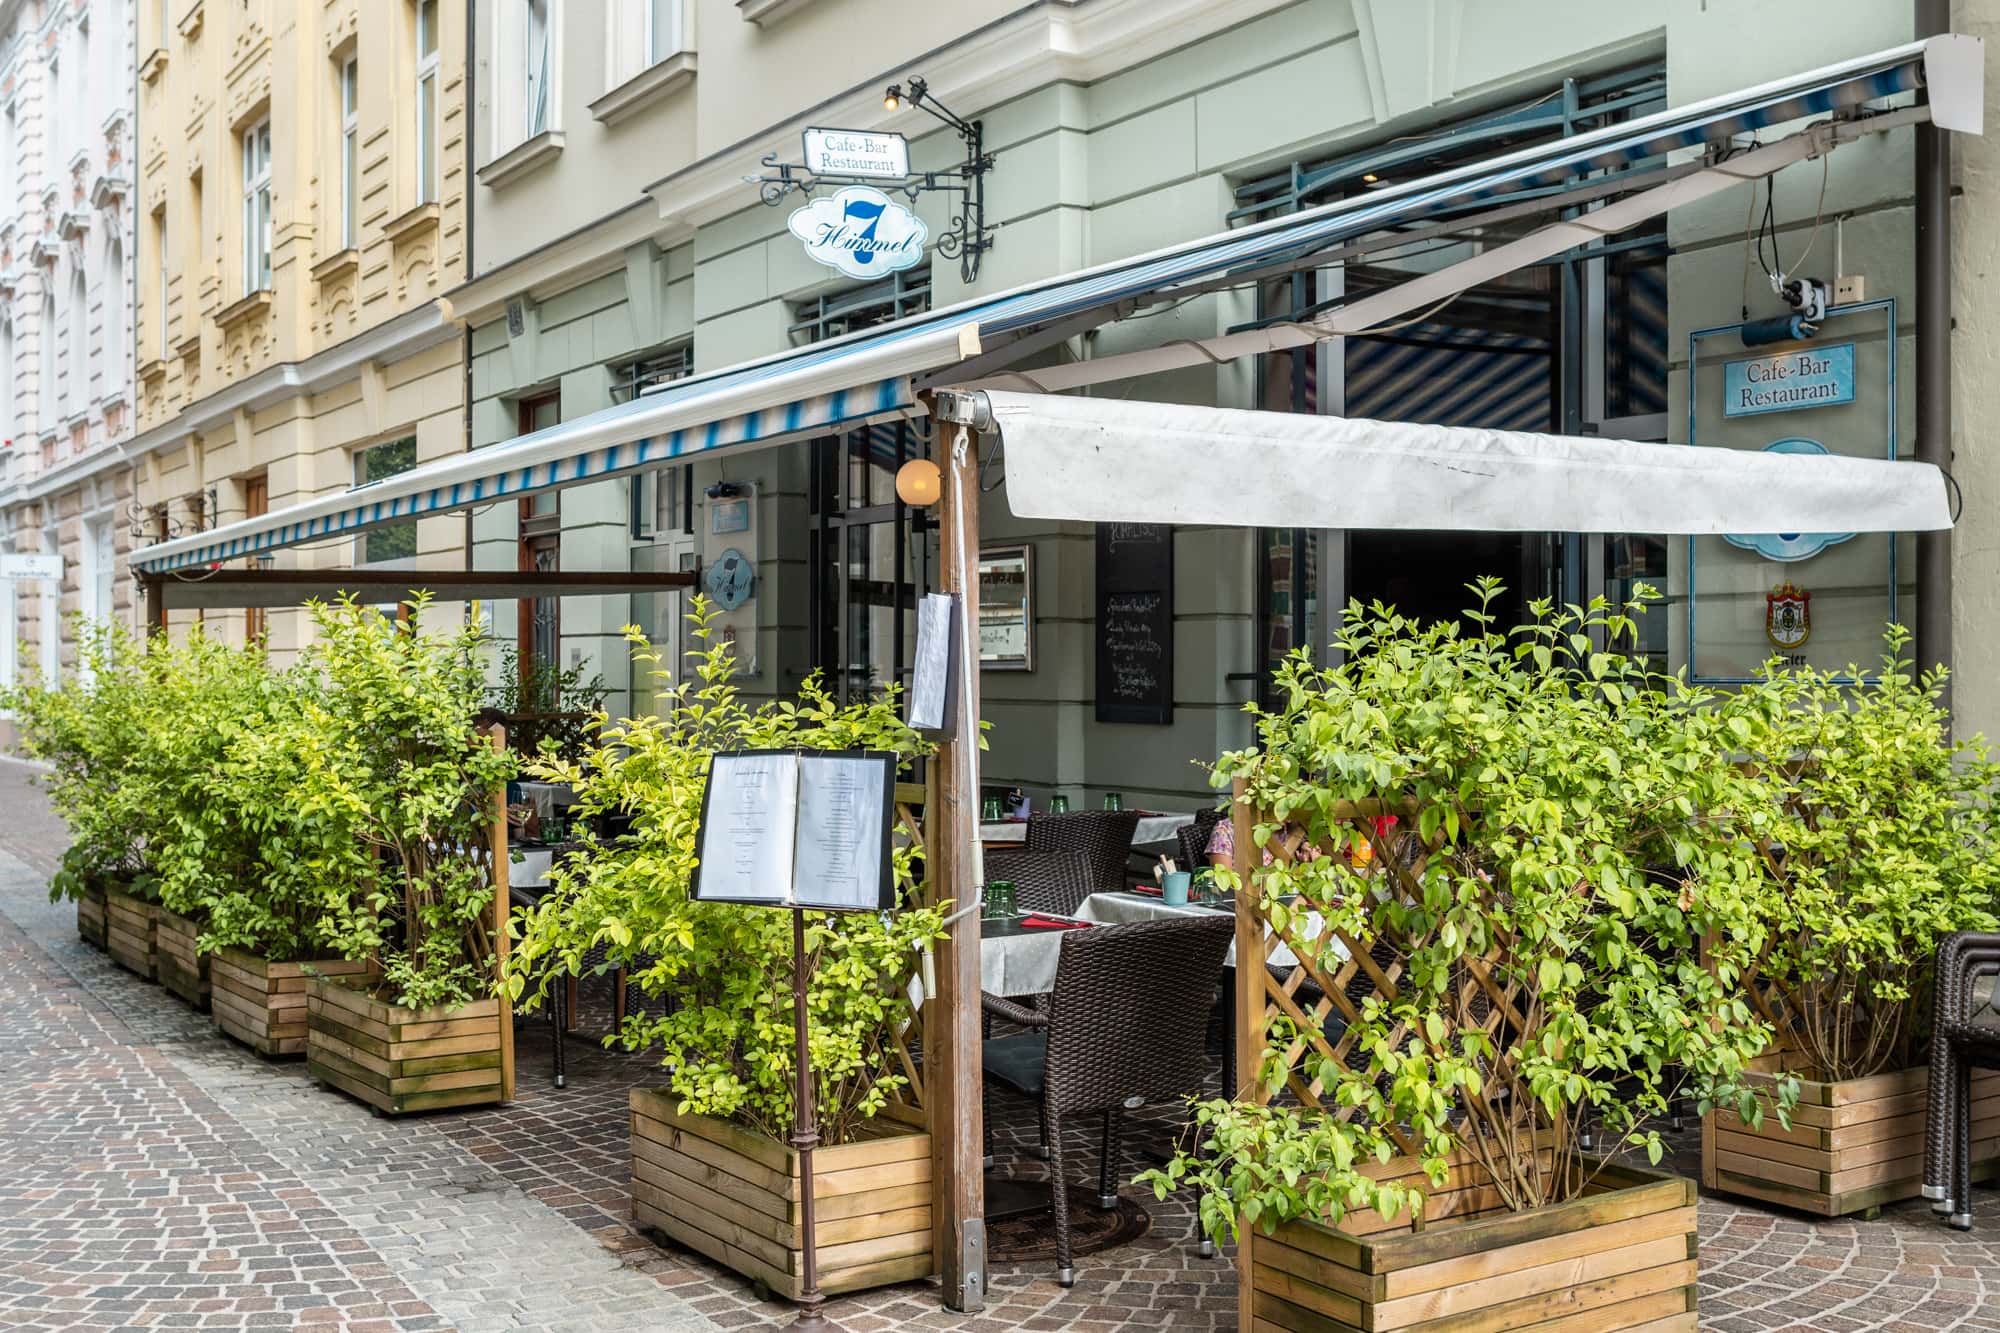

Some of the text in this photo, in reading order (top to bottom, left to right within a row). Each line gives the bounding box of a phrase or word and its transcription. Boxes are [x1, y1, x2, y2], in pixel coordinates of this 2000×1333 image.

[820, 152, 896, 172] Restaurant
[809, 222, 921, 253] Himmel
[843, 199, 887, 265] 7
[1739, 381, 1838, 408] Restaurant
